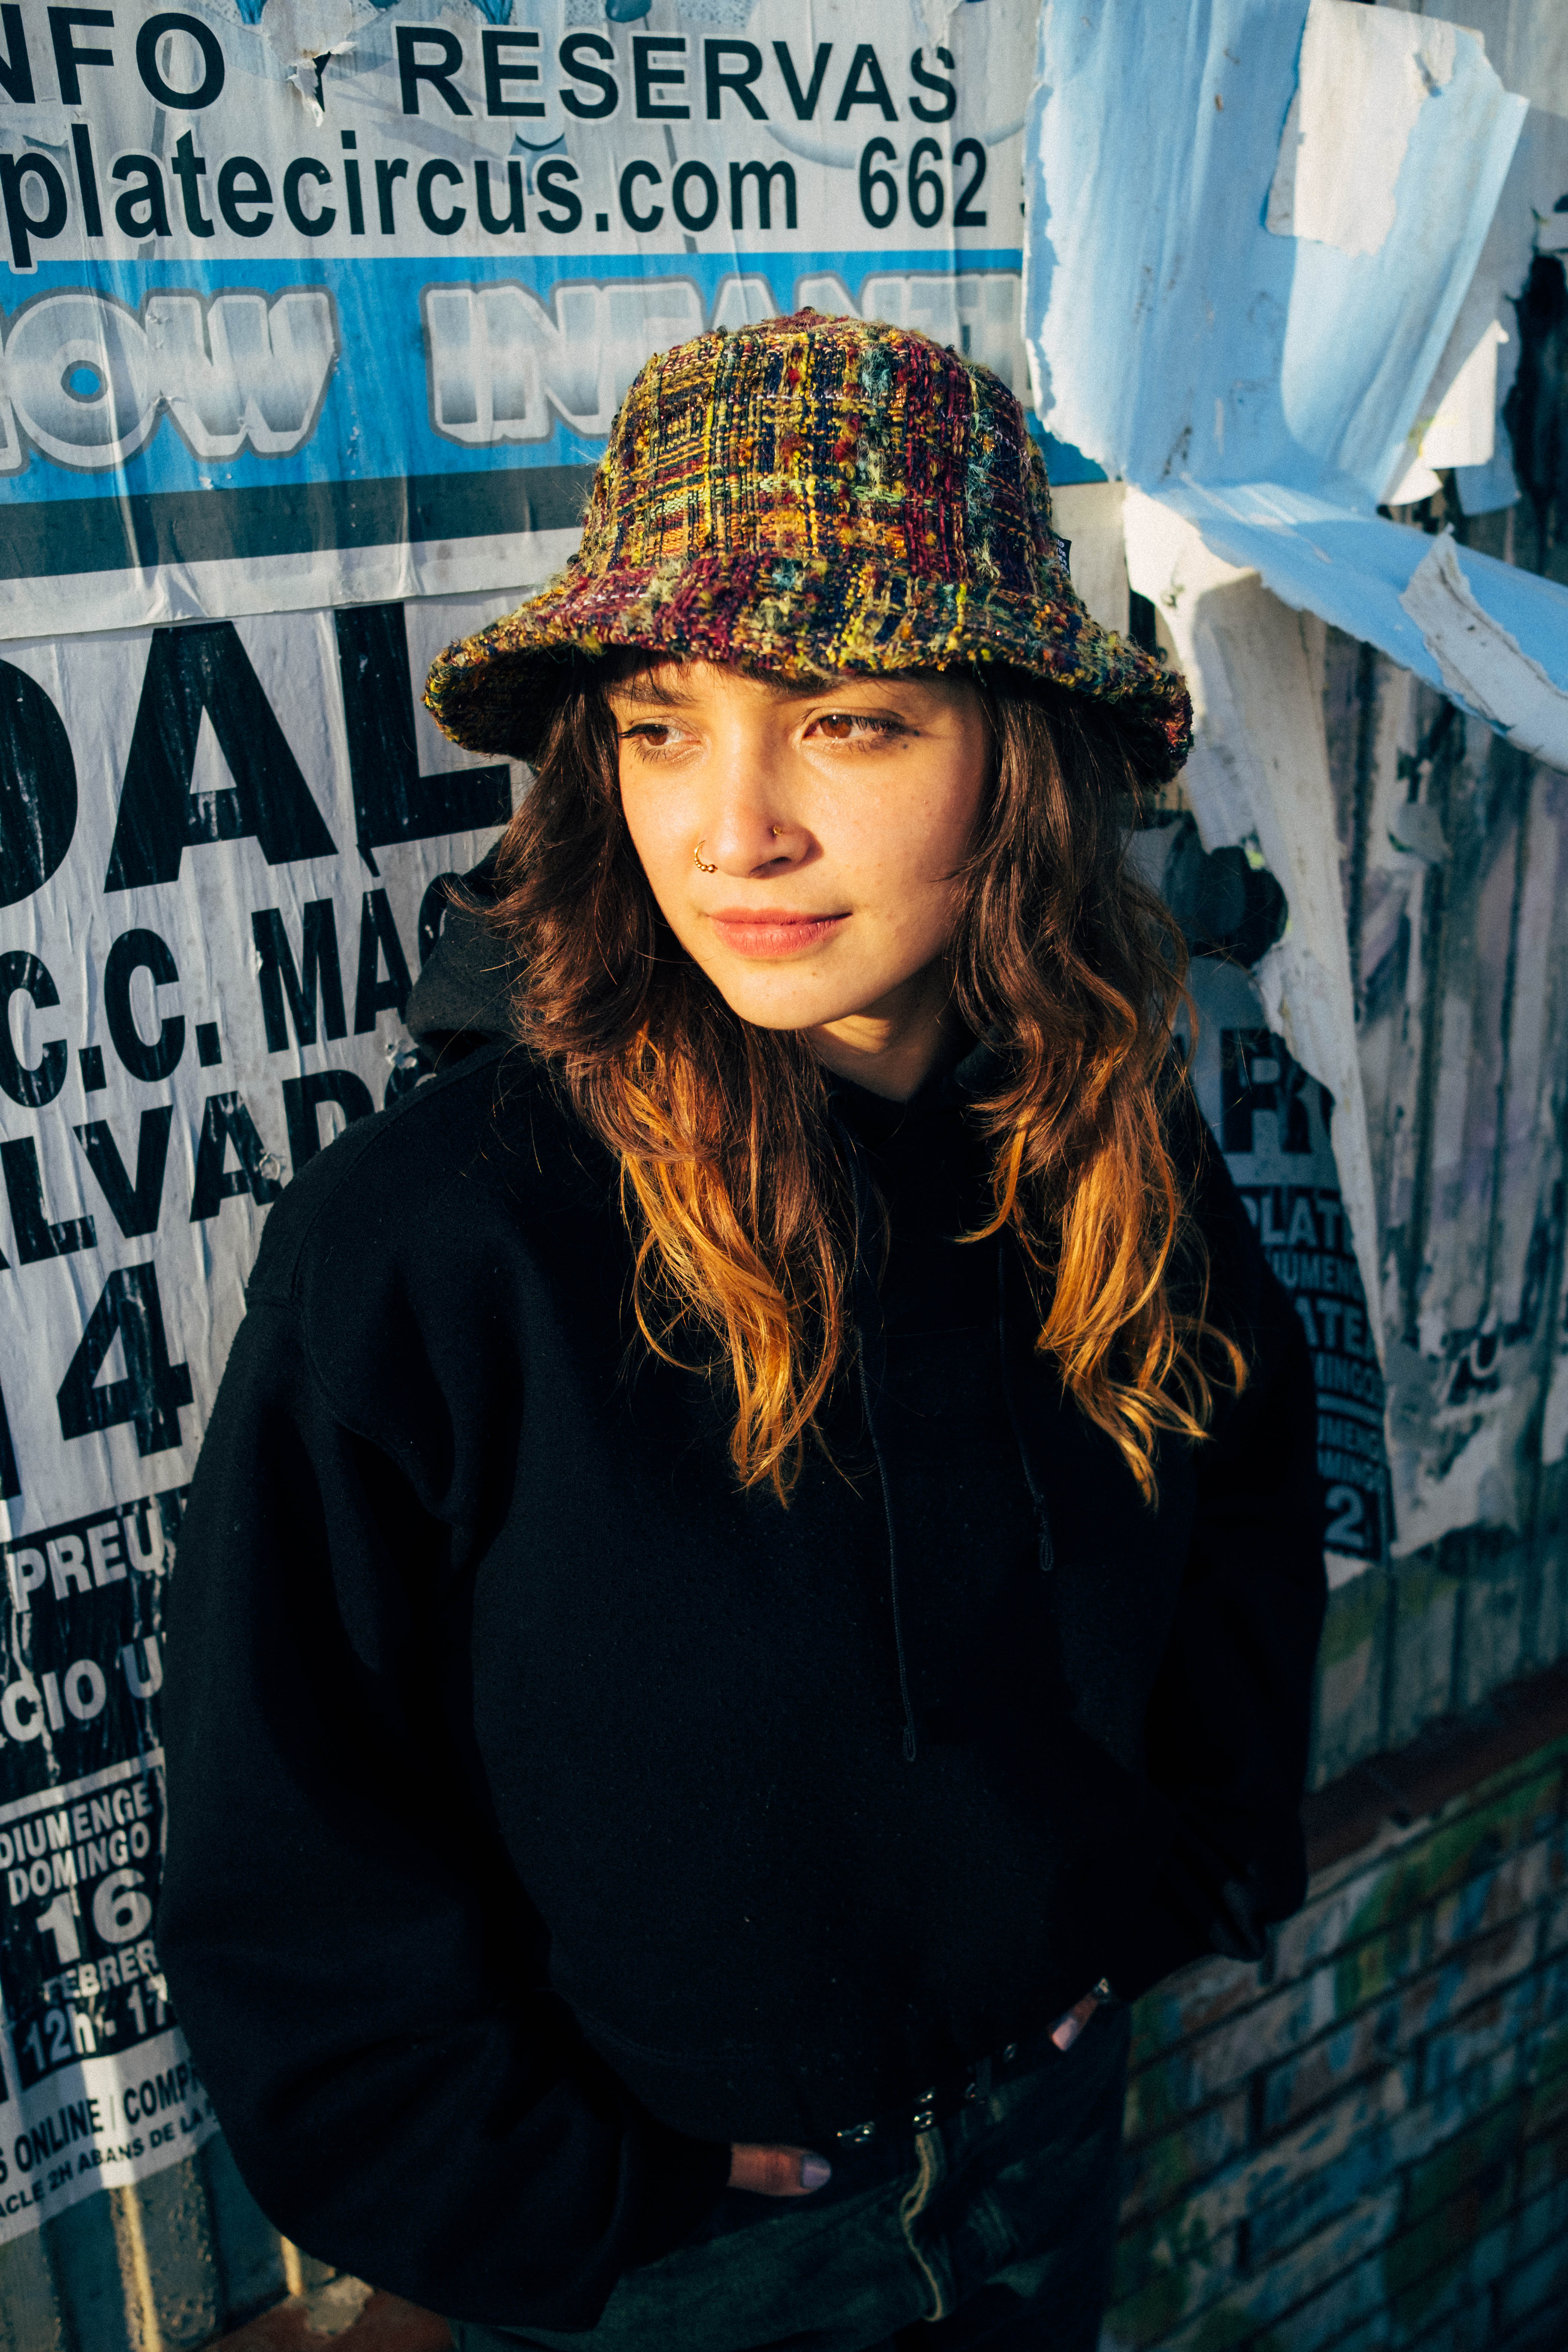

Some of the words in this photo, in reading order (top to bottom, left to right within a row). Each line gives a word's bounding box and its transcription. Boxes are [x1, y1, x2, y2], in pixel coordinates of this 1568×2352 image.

[395, 26, 956, 123] RESERVAS
[0, 124, 797, 268] platecircus.com
[859, 136, 988, 229] 662
[0, 285, 341, 476] OW
[0, 928, 222, 1108] C.C.
[0, 1050, 435, 1270] LVAD
[6, 1508, 166, 1613] PREU
[0, 1659, 107, 1742] CIO
[0, 1781, 153, 1870] DIUMENGE
[7, 1822, 150, 1906] DOMINGO
[37, 1868, 152, 1964] 16
[15, 2097, 103, 2173] ONLINE
[48, 2161, 74, 2191] 2H
[78, 2138, 145, 2173] ABANS
[150, 2122, 175, 2148] DE
[180, 2108, 204, 2133] LA
